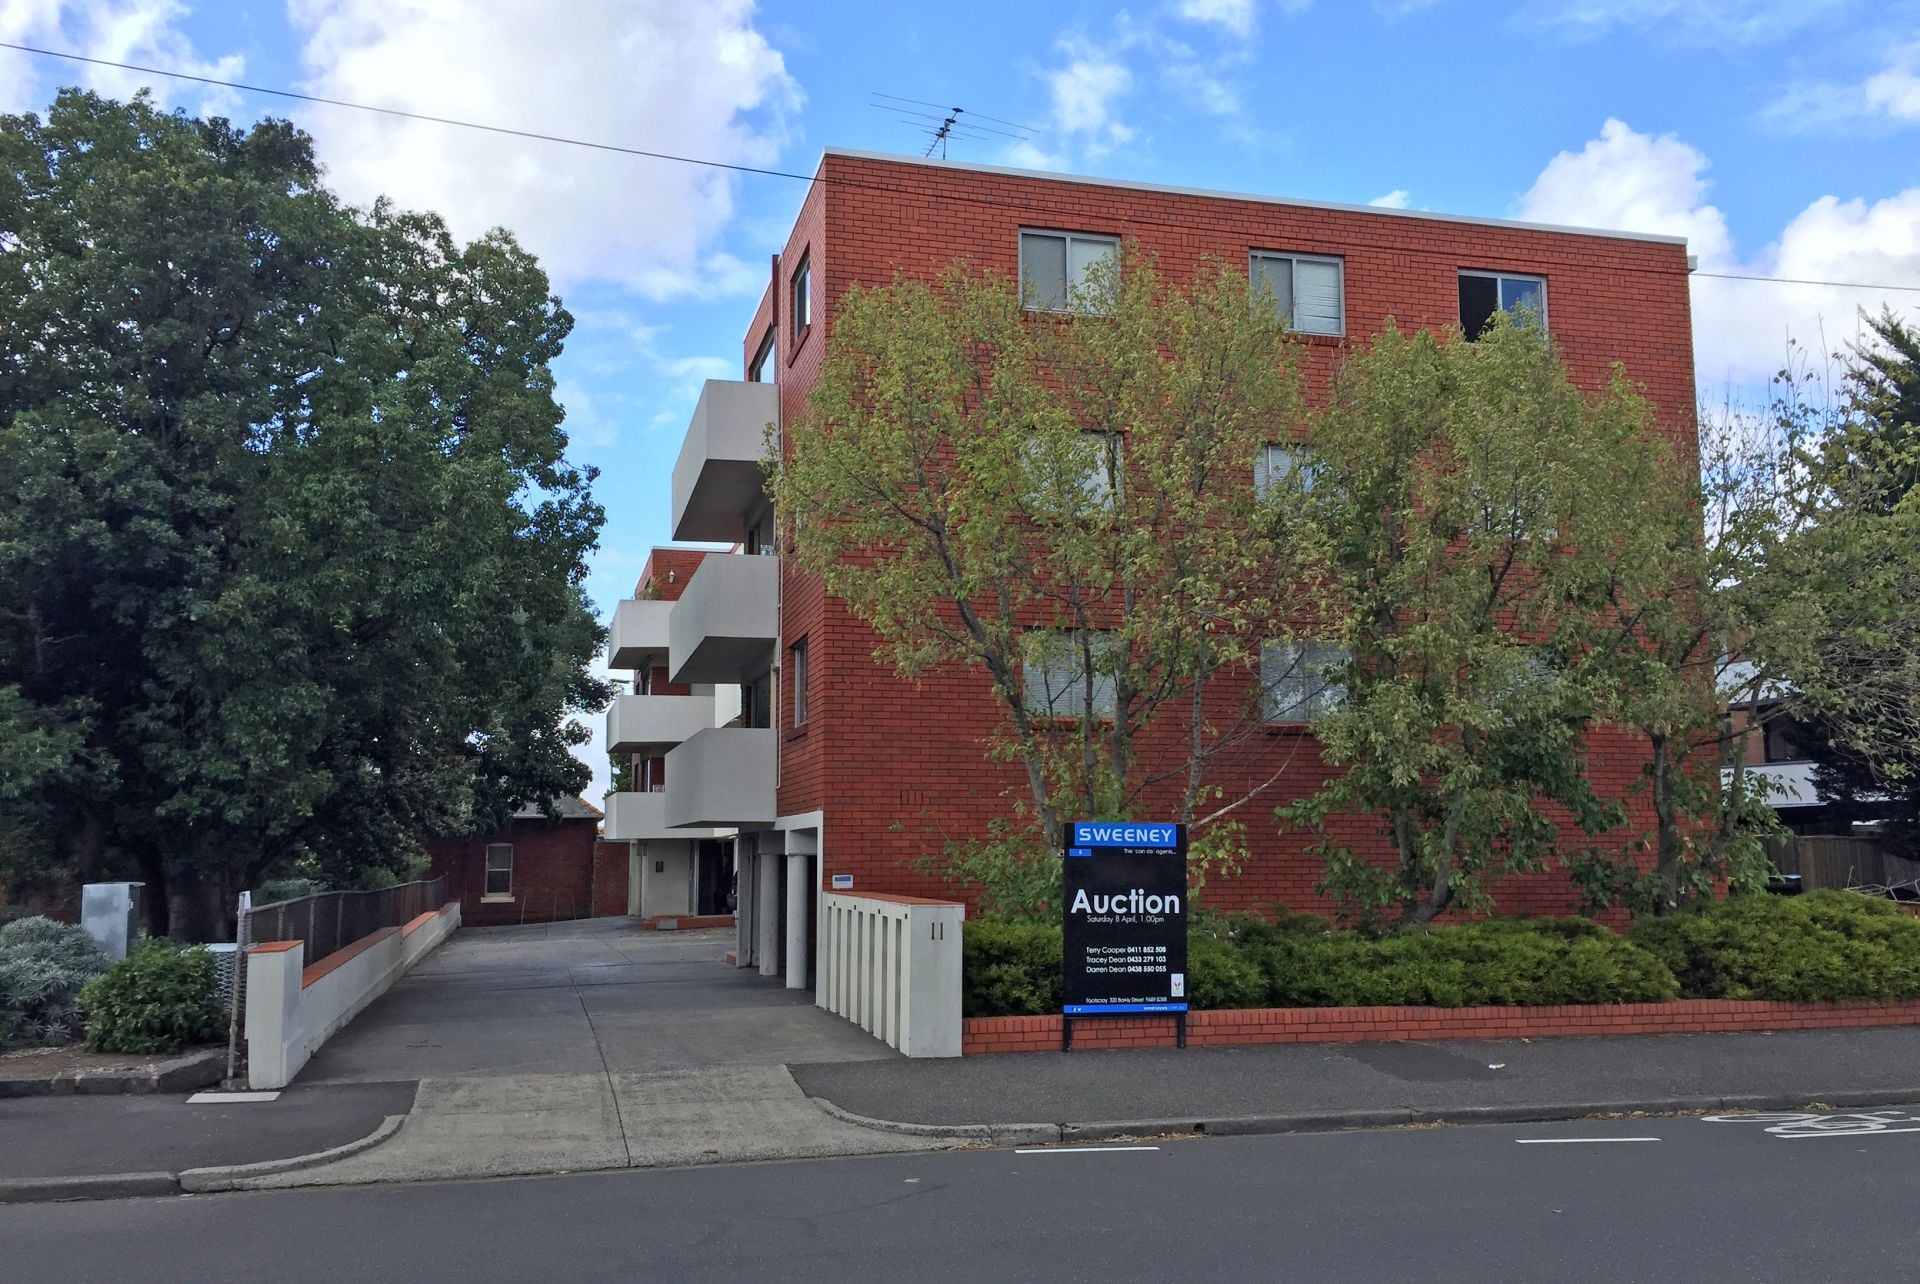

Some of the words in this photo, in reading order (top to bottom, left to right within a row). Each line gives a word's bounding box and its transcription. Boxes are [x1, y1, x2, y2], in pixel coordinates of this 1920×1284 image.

[1079, 828, 1172, 842] SWEENEY
[1070, 888, 1180, 914] Auction
[1086, 915, 1113, 924] Saturday
[1121, 915, 1138, 924] April,
[1140, 915, 1165, 924] 1.00pm
[931, 922, 944, 940] 11
[1086, 946, 1101, 954] Terry
[1101, 946, 1126, 954] Cooper
[1086, 956, 1108, 964] Tracey
